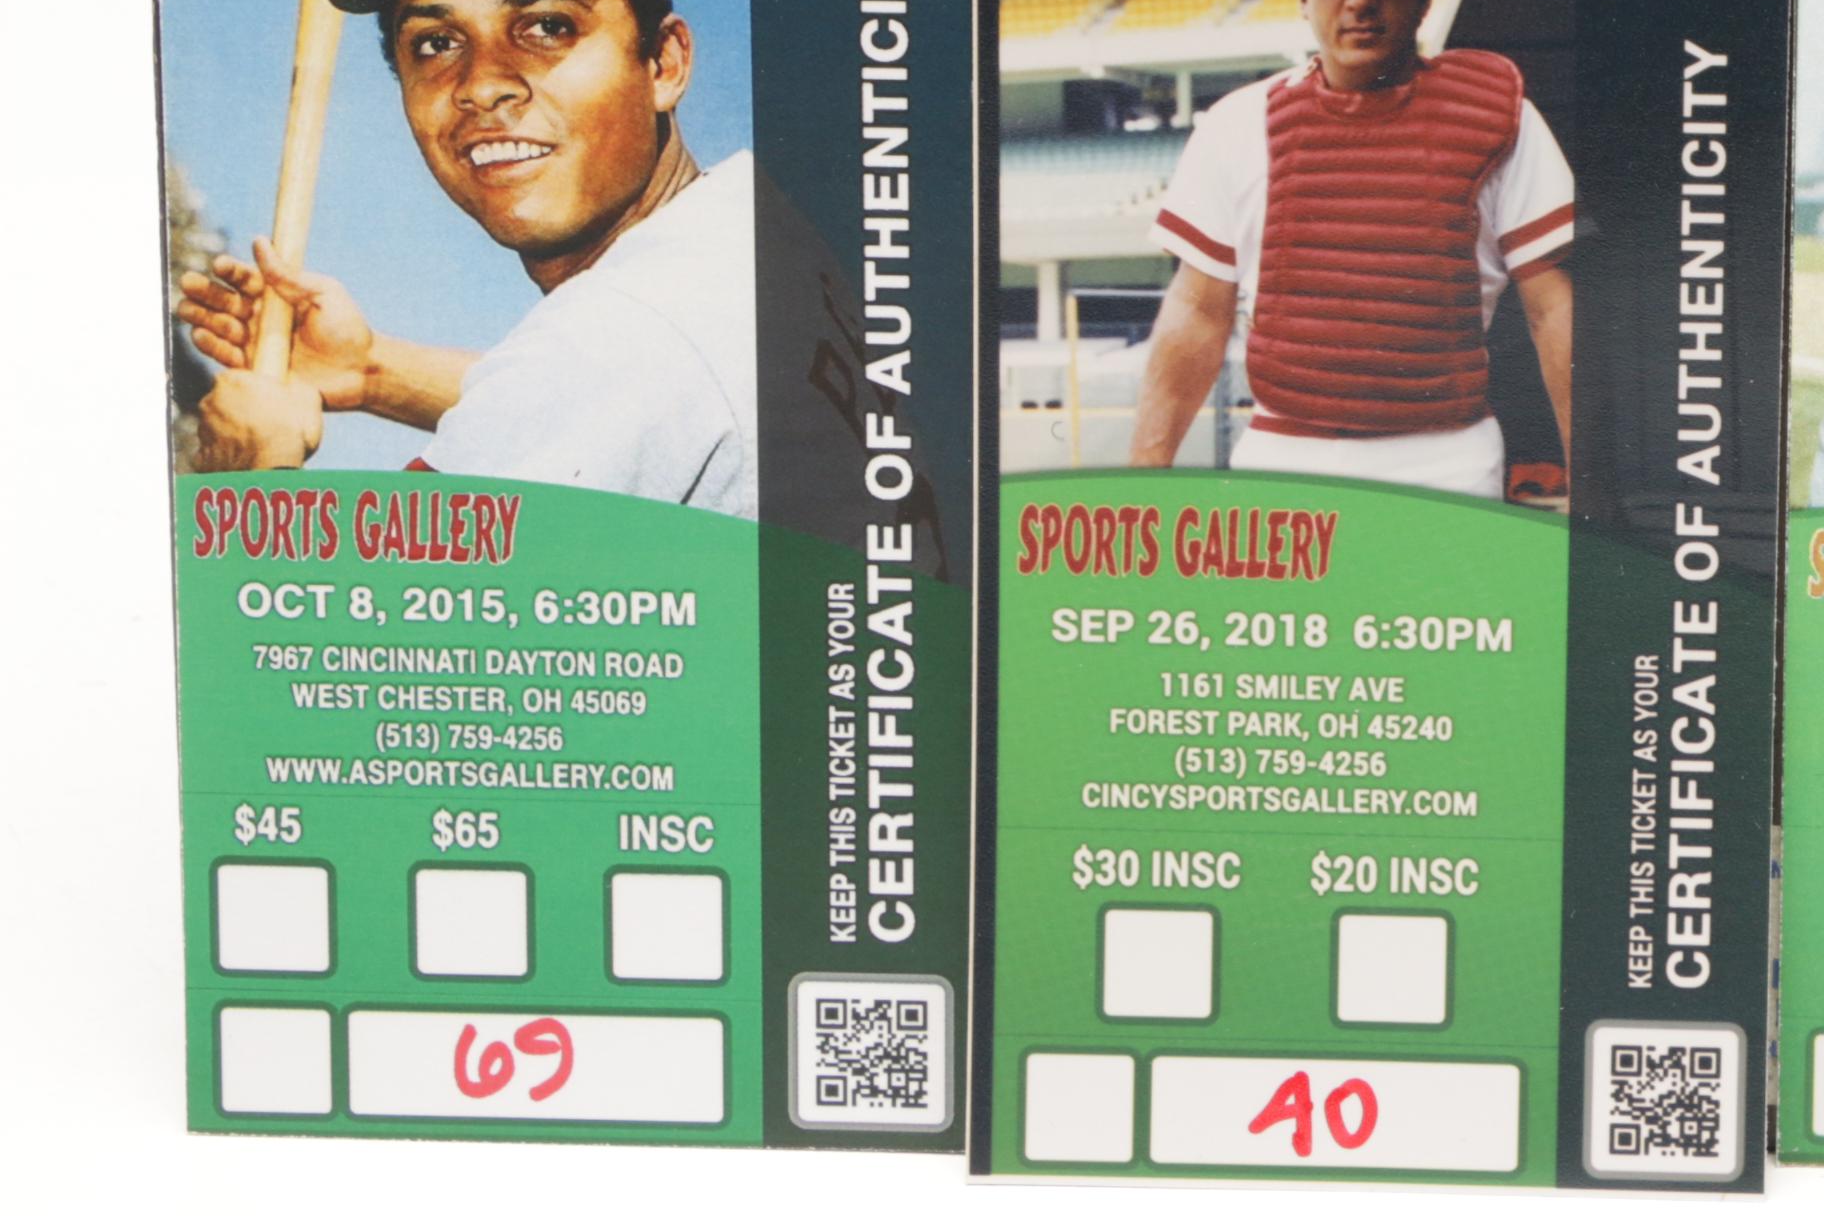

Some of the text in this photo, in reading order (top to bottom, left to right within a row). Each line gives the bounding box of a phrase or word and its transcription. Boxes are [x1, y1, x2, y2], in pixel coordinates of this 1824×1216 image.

[864, 412, 914, 501] OF
[194, 487, 523, 565] SPORTS GALLERY
[1665, 39, 1728, 989] CERTIFICATE OF AUTHENTICITY
[1018, 504, 1339, 582] SPORTS GALLERY
[238, 582, 696, 629] OCT 8, 2015, 6:30PM
[1052, 608, 1512, 652] SEP 26, 2018 6:30PM
[252, 645, 684, 679] 7967 CINCINNATI DAYTON ROAD
[291, 683, 647, 716] WEST CHESTER, OH 45069
[1161, 672, 1404, 703] 1161 SMILEY AVE
[375, 722, 564, 754] (513) 759-4256
[866, 523, 916, 943] CERTIFICATE
[1109, 708, 1453, 742] FOREST PARK, OH 45240
[266, 757, 674, 791] WWW.ASPORTSGALLERY.COM
[827, 583, 857, 943] KEEP THIS TICKET AS YOUR
[1174, 746, 1387, 779] (513) 759-4256
[1082, 782, 1478, 817] CINCYSPORTSGALLERY.COM
[1628, 655, 1659, 989] KEEP THIS TICKET AS YOUR
[234, 803, 302, 846] $45
[432, 809, 500, 852] $65
[619, 814, 714, 853] INSC
[1072, 844, 1241, 890] $30 INSC
[1310, 850, 1479, 896] $20 INSC
[453, 1016, 575, 1102] 69
[1248, 1071, 1378, 1157] 40
